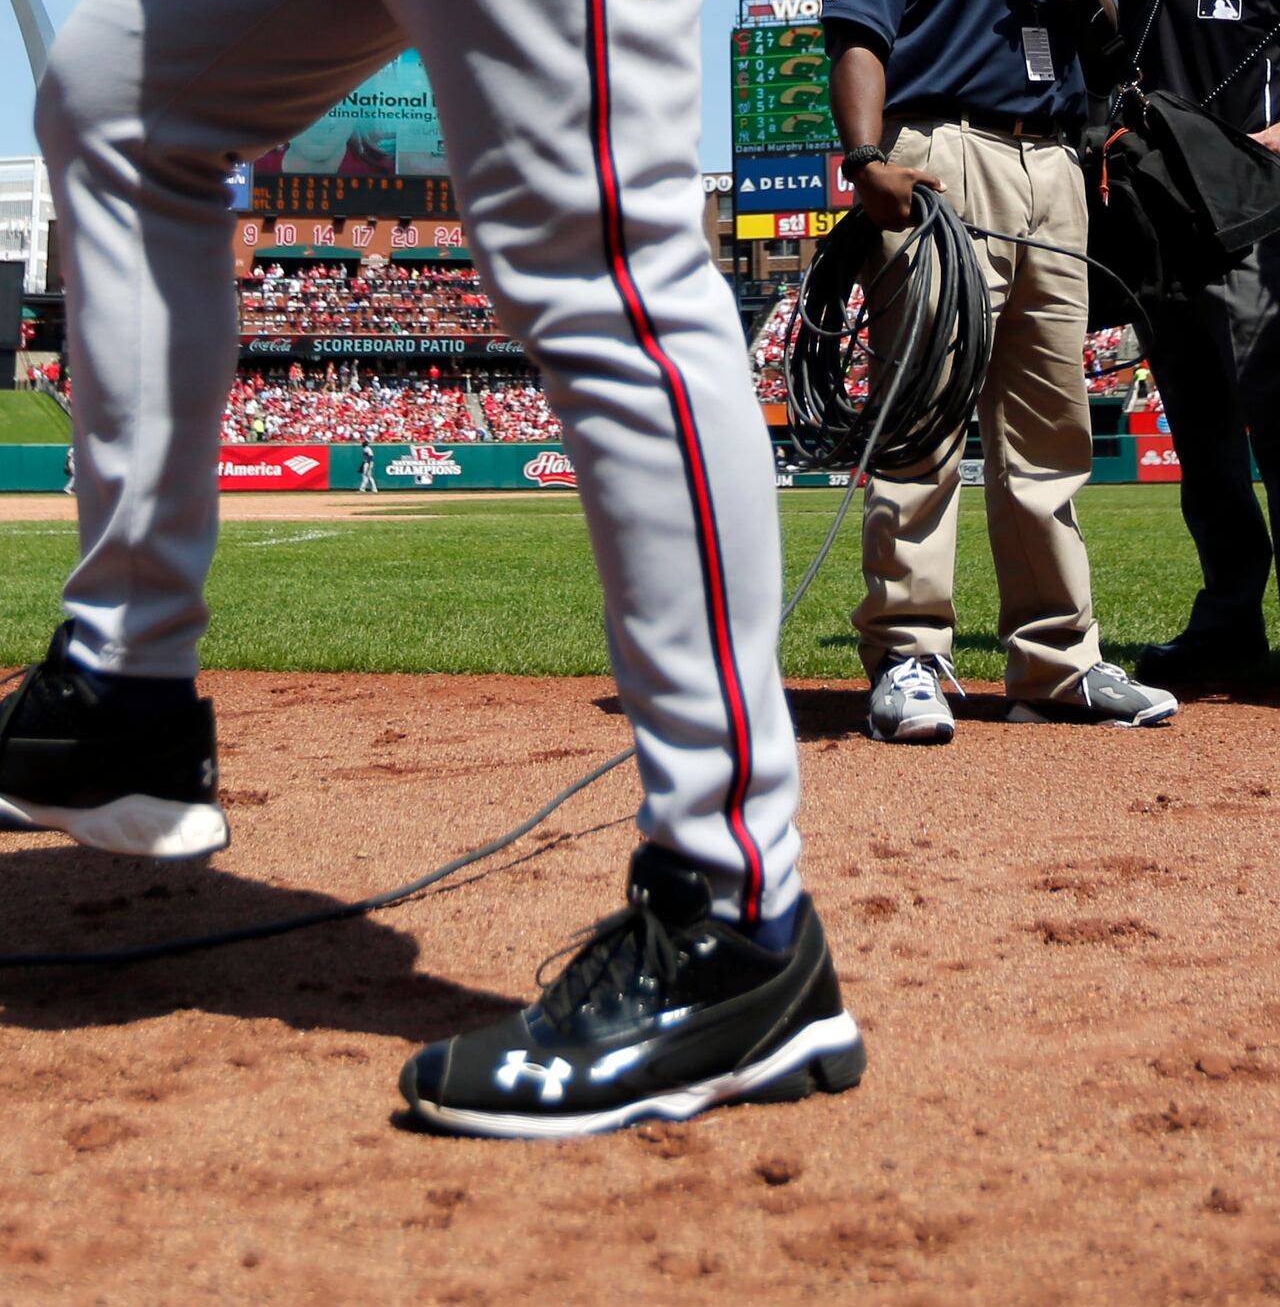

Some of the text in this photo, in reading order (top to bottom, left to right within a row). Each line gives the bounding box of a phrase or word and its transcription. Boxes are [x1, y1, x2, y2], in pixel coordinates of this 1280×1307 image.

[755, 31, 764, 43] 2
[755, 44, 765, 55] 4
[755, 59, 764, 70] 0
[755, 72, 765, 83] 4
[342, 91, 427, 108] National
[756, 88, 764, 99] 3
[756, 101, 765, 112] 5
[757, 116, 765, 128] 3
[757, 130, 766, 140] 4
[759, 175, 823, 190] DELTA
[243, 223, 462, 248] 9 10 14 17 20 24
[313, 339, 466, 353] SCOREBOARD PATIO
[223, 462, 283, 477] America
[385, 464, 462, 476] CHAMPIONS
